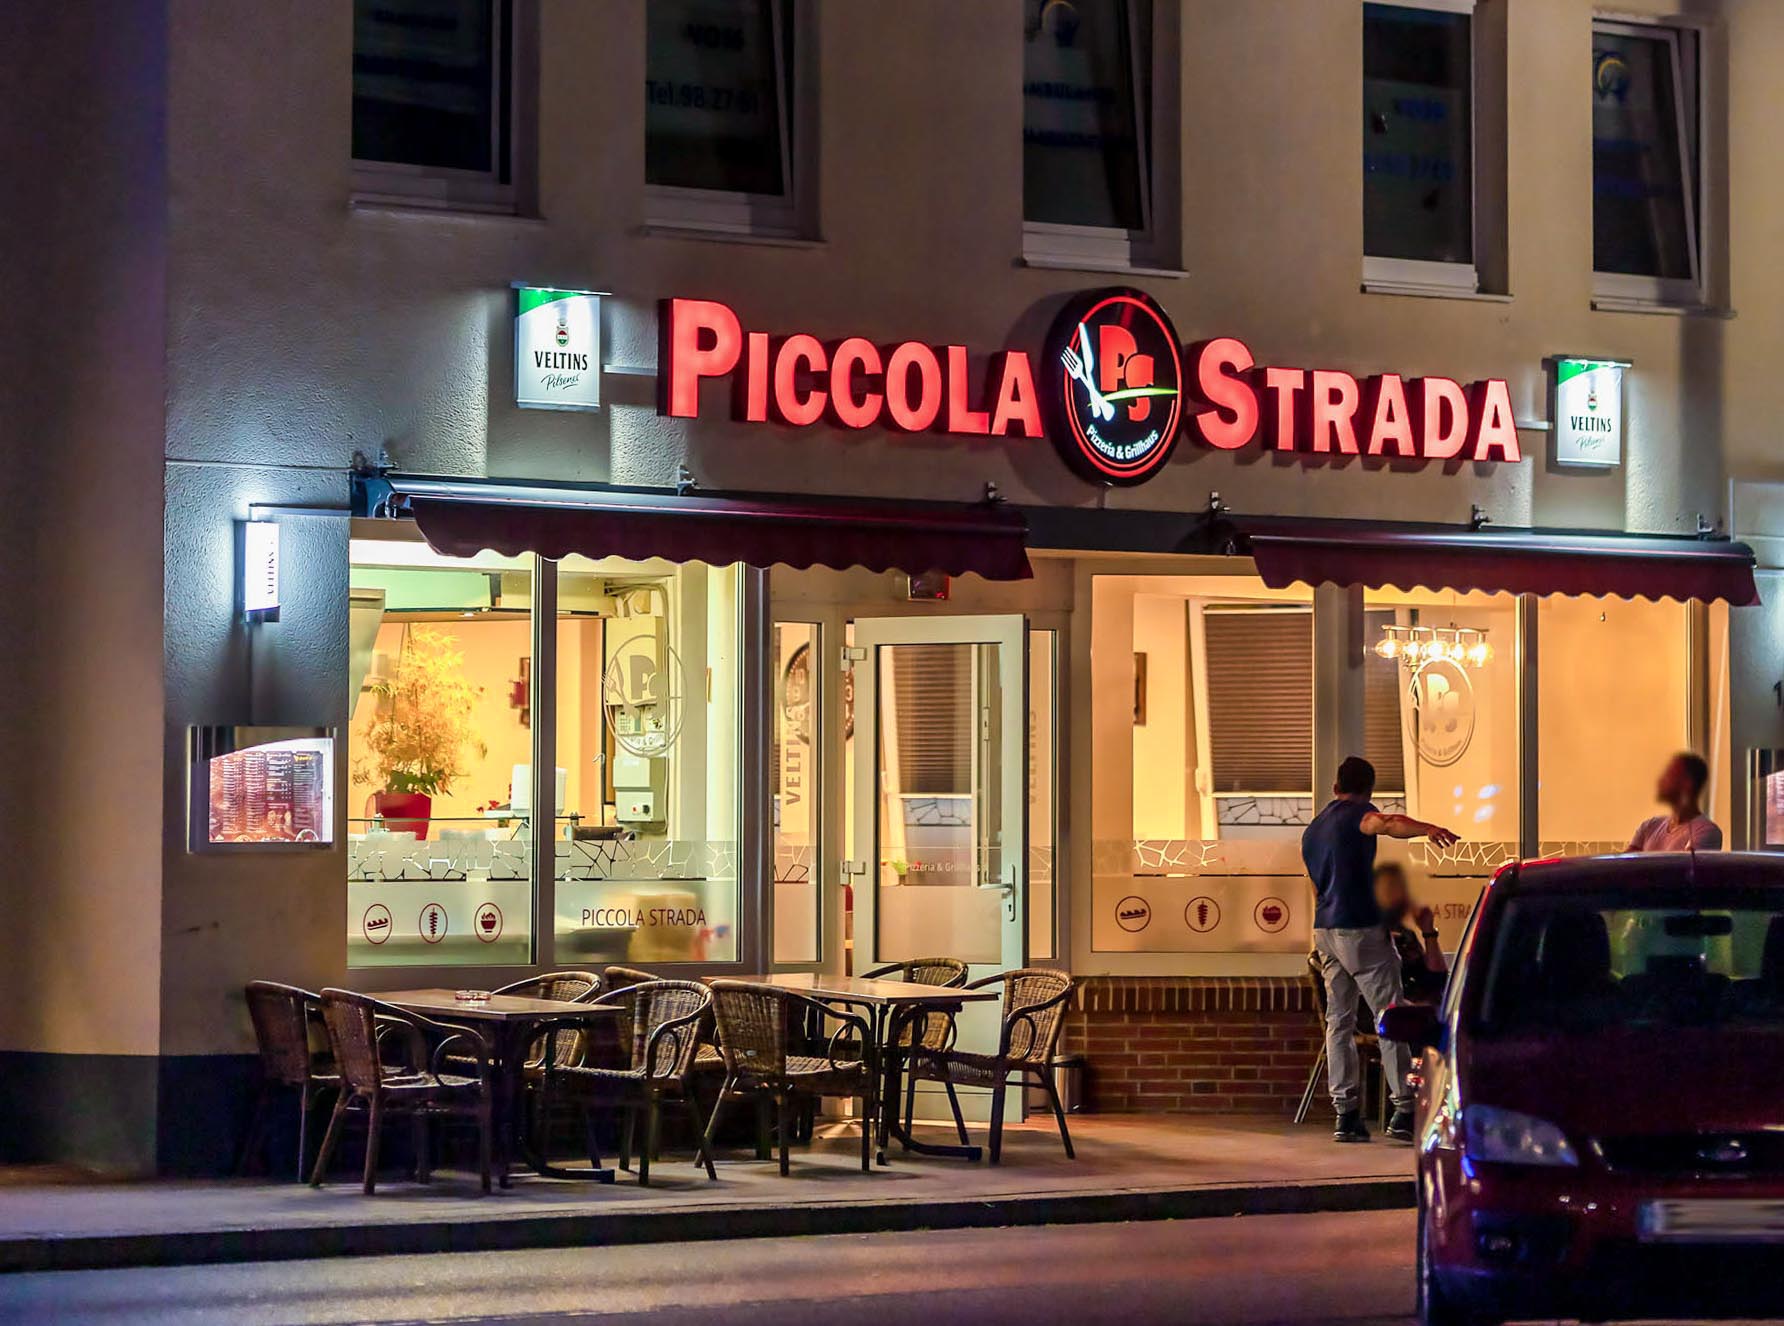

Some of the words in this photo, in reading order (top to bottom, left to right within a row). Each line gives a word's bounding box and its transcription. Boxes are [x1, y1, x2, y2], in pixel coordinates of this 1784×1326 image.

[534, 350, 588, 371] VELTINS
[664, 297, 1044, 438] PICCOLA
[1195, 337, 1521, 463] STRADA
[1099, 324, 1155, 423] PS
[1570, 415, 1612, 433] VELTINS
[1085, 424, 1116, 458] Pizzeria
[1115, 446, 1124, 460] &
[1124, 429, 1160, 460] Grillhaus
[581, 908, 646, 927] PICCOLA
[648, 908, 707, 927] STRADA
[1444, 903, 1472, 920] STRA
